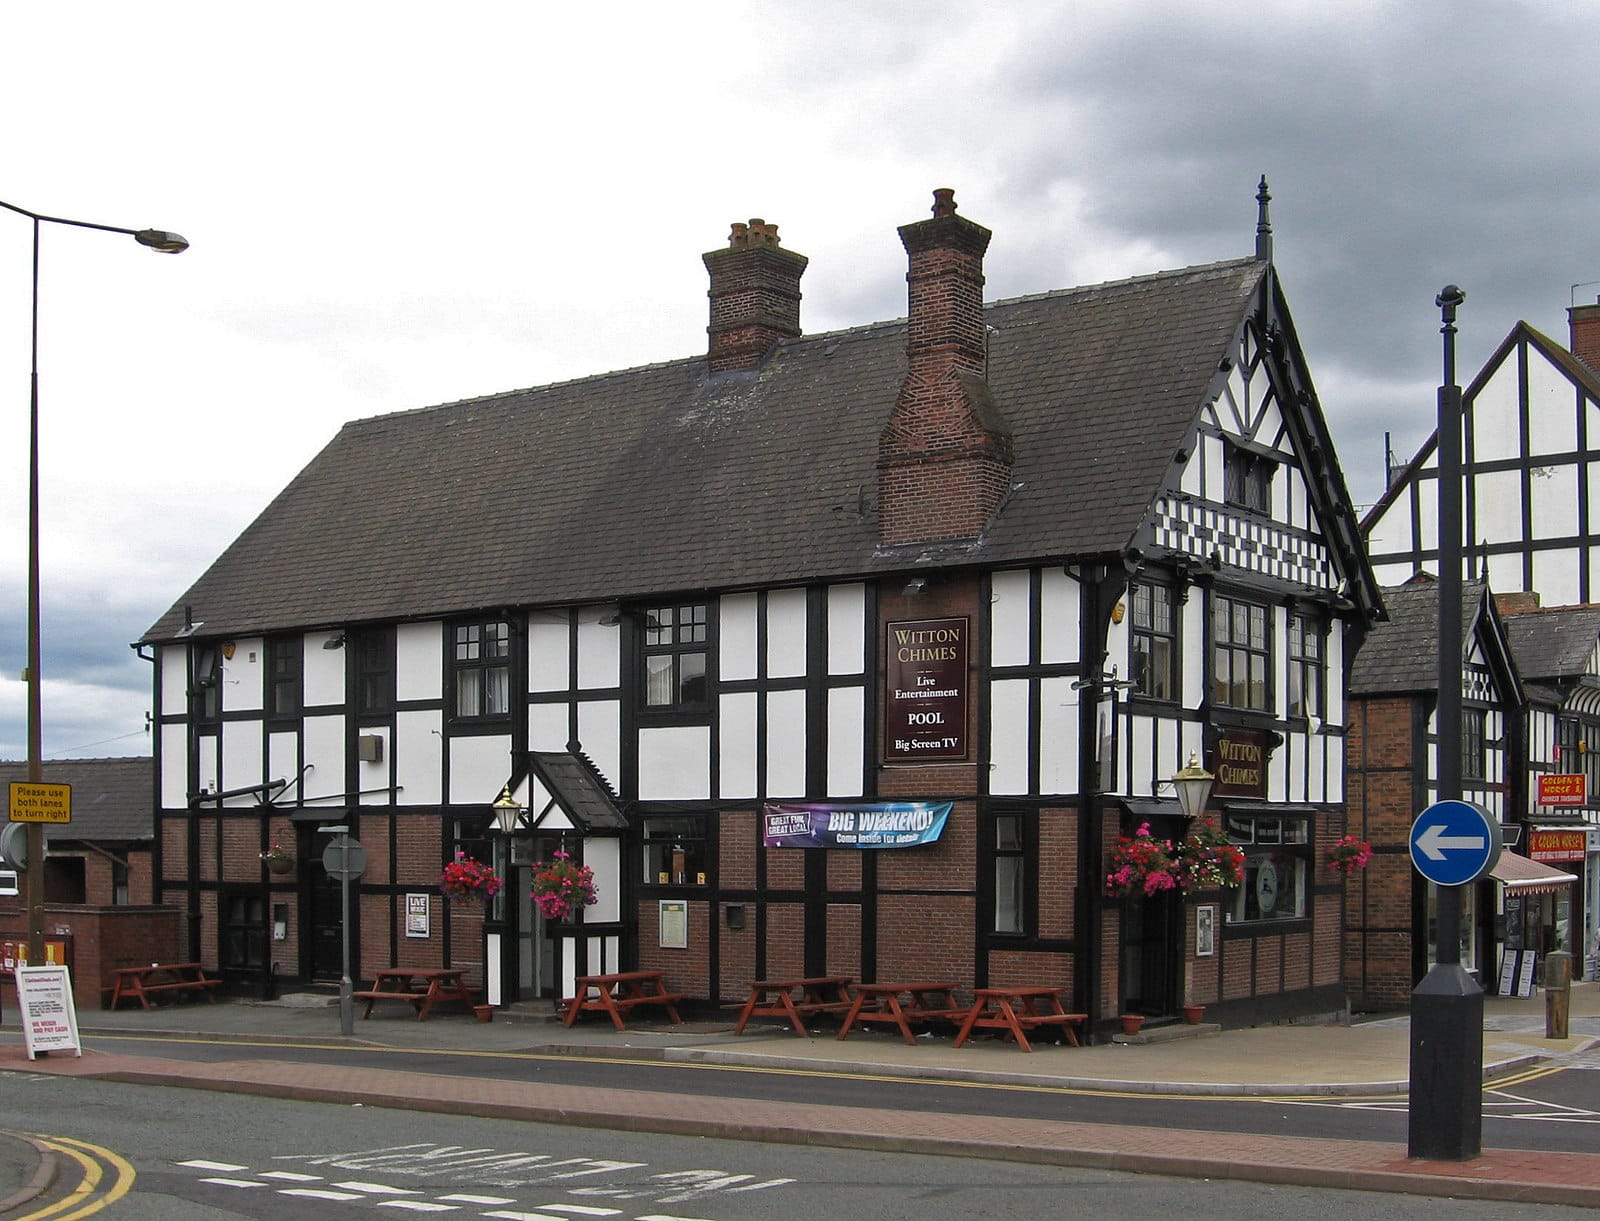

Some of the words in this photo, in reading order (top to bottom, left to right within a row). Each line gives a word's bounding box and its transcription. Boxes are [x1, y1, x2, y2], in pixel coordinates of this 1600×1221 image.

[895, 629, 960, 645] WITTON
[898, 647, 957, 662] CHIMES
[917, 676, 936, 687] Live
[895, 688, 959, 699] Entertainment
[908, 712, 945, 726] POOL
[895, 739, 910, 751] Big
[911, 739, 940, 749] Screen
[942, 737, 959, 748] TV
[1219, 739, 1261, 761] WITTON
[1219, 764, 1259, 785] CHIMES
[1542, 777, 1573, 785] GOLDEN
[17, 786, 46, 796] Please
[48, 789, 64, 797] use
[17, 798, 37, 806] both
[40, 799, 63, 808] lanes
[14, 809, 23, 817] to
[25, 809, 44, 817] turn
[46, 810, 67, 819] right
[771, 815, 790, 826] GREAT
[828, 811, 855, 831] BIG
[859, 810, 934, 831] WEEKEND!
[769, 823, 789, 835] GREAT
[836, 833, 857, 843] Come
[883, 833, 895, 843] for
[1538, 834, 1561, 849] GOLDEN
[410, 898, 425, 906] LIVE
[271, 1143, 648, 1188] ENTRY
[567, 1169, 797, 1203] NO
